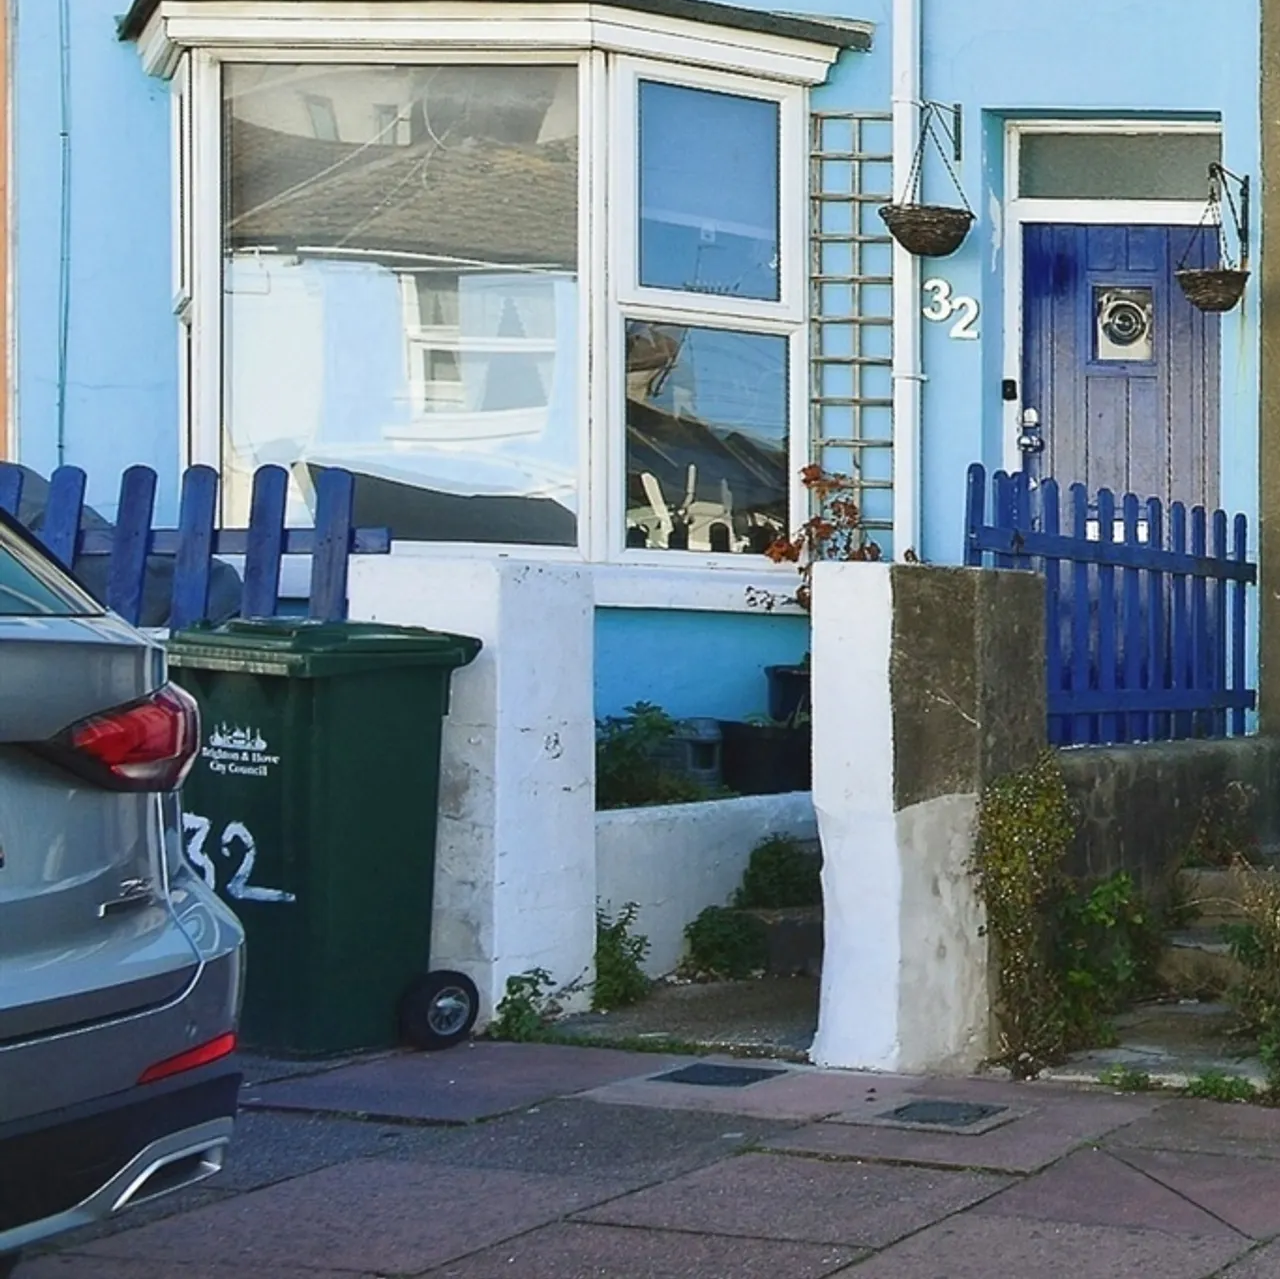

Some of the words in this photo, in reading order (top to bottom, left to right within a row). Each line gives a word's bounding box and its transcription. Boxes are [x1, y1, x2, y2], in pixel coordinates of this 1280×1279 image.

[922, 277, 980, 340] 32
[228, 762, 267, 776] Council
[182, 812, 296, 902] 32
